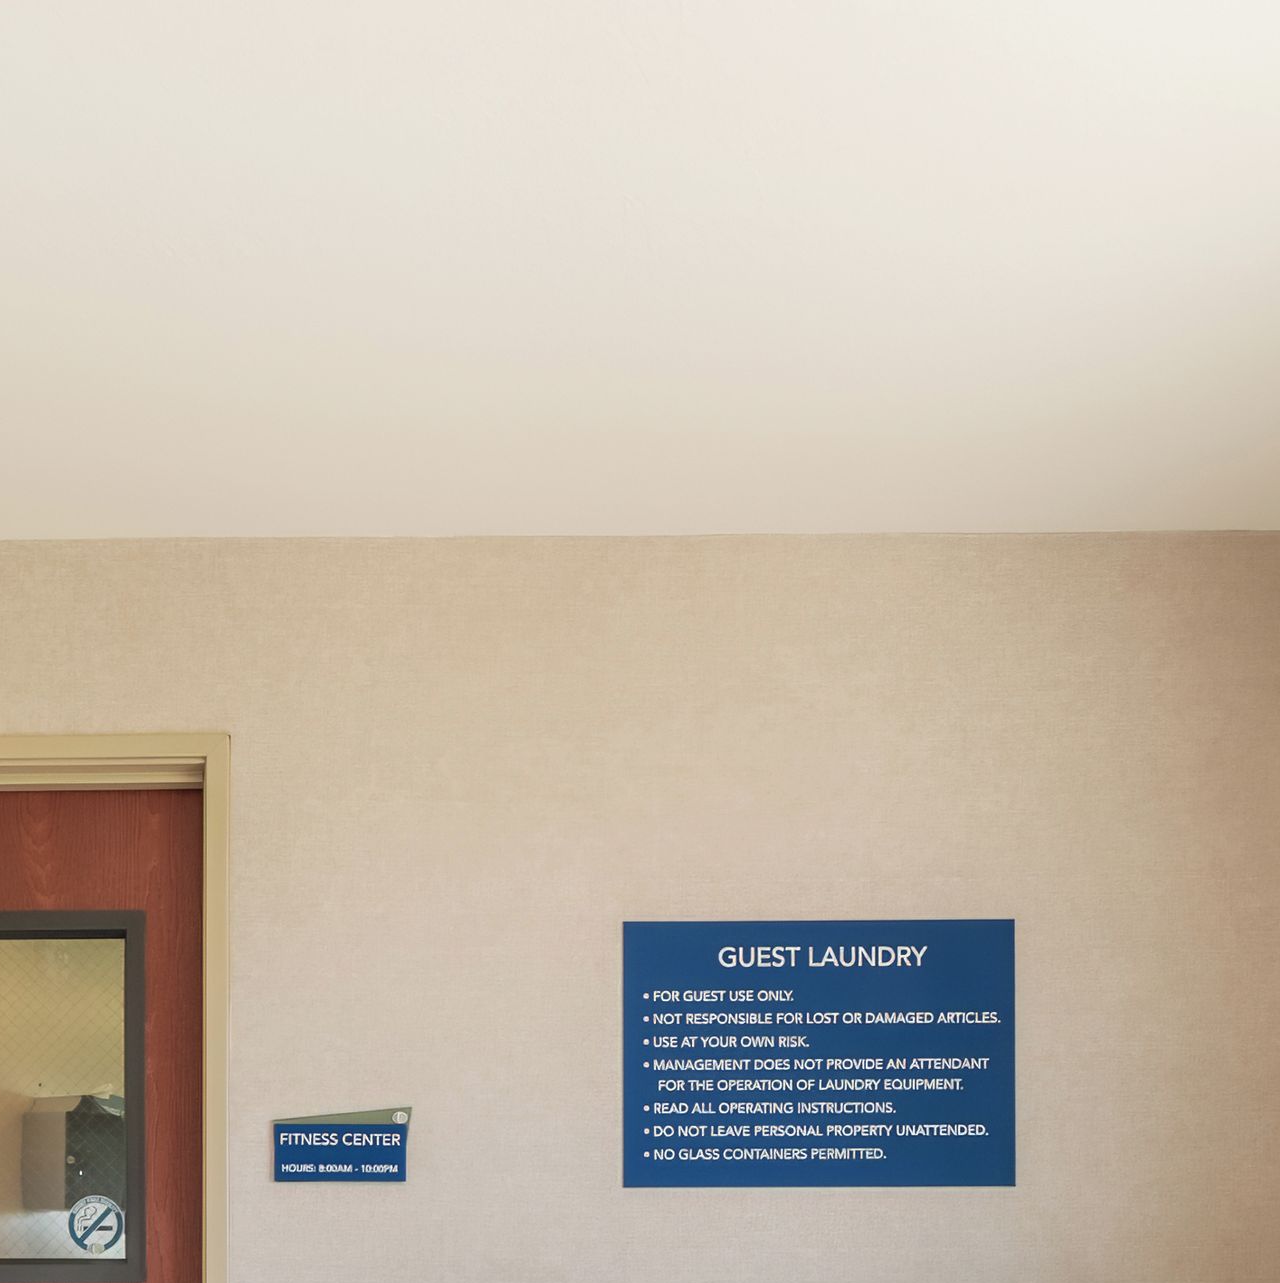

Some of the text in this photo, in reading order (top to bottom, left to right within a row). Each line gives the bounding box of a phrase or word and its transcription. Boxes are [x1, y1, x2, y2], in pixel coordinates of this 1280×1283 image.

[718, 945, 928, 968] GUEST LAUNDRY
[653, 989, 794, 1002] FOR GUEST USE ONLY.
[652, 1011, 1002, 1025] NOT RESPONSIBLE FOR LOST OR DAMAGED ARTICLES.
[653, 1035, 810, 1048] USE AT YOUR OWN RISK.
[653, 1057, 990, 1071] MANAGEMENT DOES NOT PROVIDE AN ATTENDANT
[658, 1078, 964, 1092] FOR THE OPERATION OF LAUNDRY EQUIPMENT.
[653, 1101, 897, 1115] READ ALL OPERATING INSTRUCTIONS.
[653, 1124, 989, 1138] DO NOT LEAVE PERSONAL PROPERTY UNATTENDED.
[279, 1132, 401, 1146] FITNESS CENTER
[653, 1147, 887, 1161] NO GLASS CONTAINERS PERMITTED.
